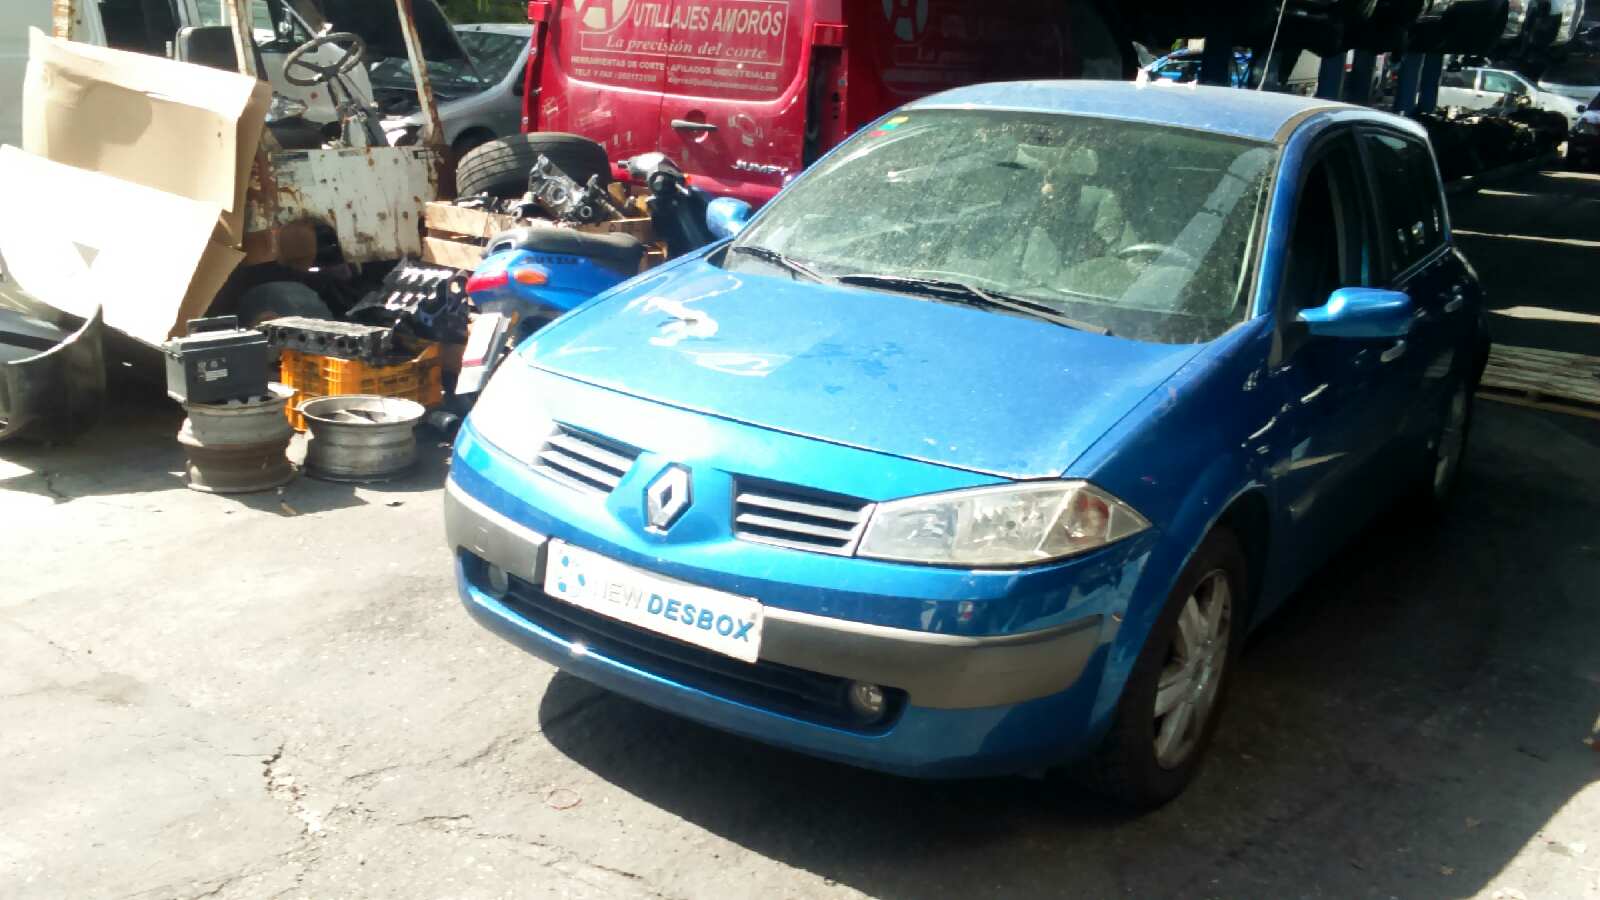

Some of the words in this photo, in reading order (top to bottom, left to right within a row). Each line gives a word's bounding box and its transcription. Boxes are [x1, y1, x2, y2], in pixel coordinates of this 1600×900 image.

[633, 3, 710, 31] UTILLAJES
[711, 4, 783, 37] AMORÓS
[606, 34, 625, 48] La
[624, 37, 692, 55] precisión
[697, 41, 722, 56] del
[725, 47, 767, 59] corte
[639, 61, 665, 71] CORTE
[671, 63, 712, 75] AFILADOS
[647, 592, 755, 643] DESBOX
